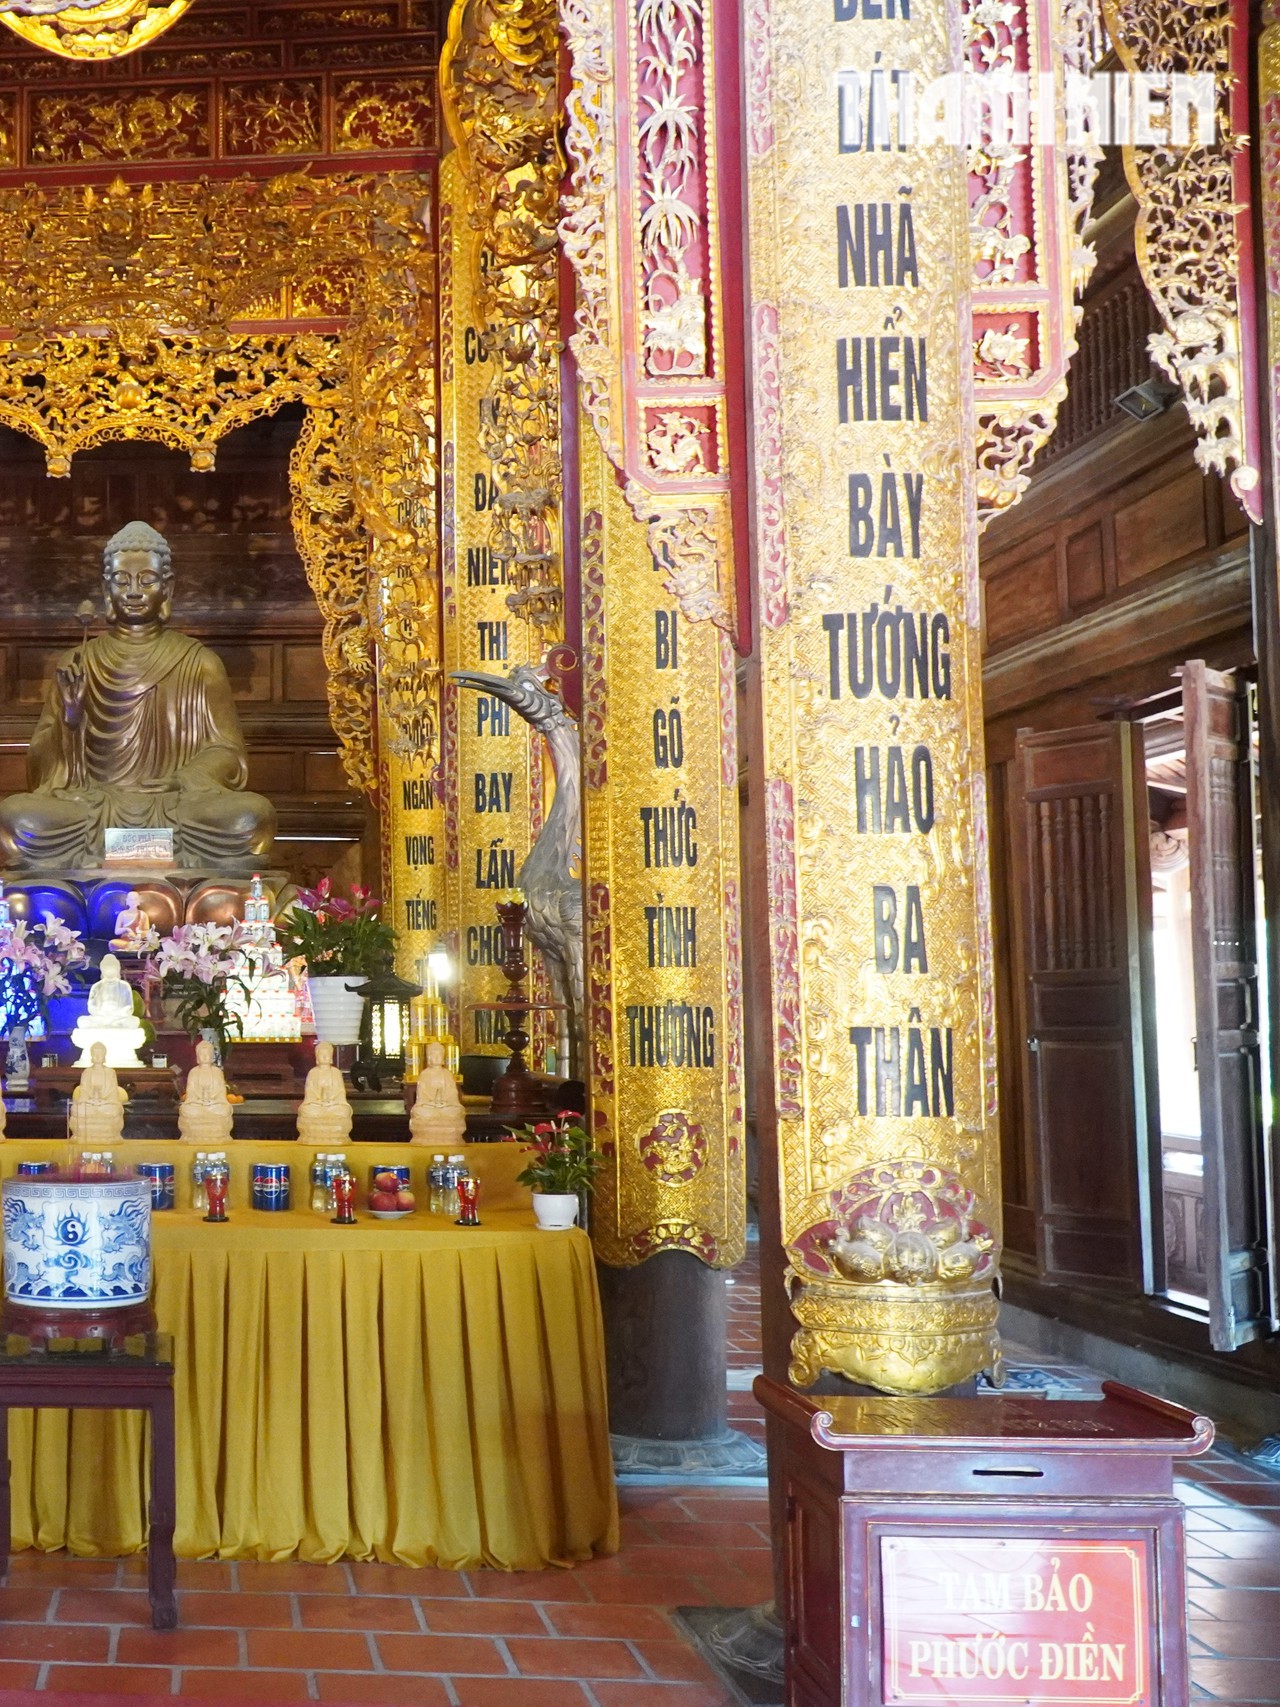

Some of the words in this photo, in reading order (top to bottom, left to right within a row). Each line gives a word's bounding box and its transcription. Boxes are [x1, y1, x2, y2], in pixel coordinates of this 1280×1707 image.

[836, 50, 912, 155] BÁT
[835, 185, 919, 290] NHÃ
[835, 306, 929, 425] HIỂN
[847, 452, 924, 560] BÀY
[477, 620, 509, 671] THỊ
[654, 609, 679, 671] BI
[821, 583, 952, 701] TƯỚNG
[476, 696, 510, 738] PHI
[652, 696, 685, 770] GÕ
[402, 777, 434, 811] NGÂN
[474, 772, 514, 814] BAY
[853, 714, 936, 835] HẢO
[405, 835, 435, 871] VỌNG
[474, 837, 516, 890] LẪN
[639, 787, 699, 869] THỨC
[405, 888, 437, 932] TIẾNG
[643, 893, 698, 968] TÌNH
[871, 884, 929, 976] BA
[625, 998, 715, 1070] THƯƠNG
[848, 1005, 956, 1118] THÂN
[939, 1571, 1013, 1612] TAM
[1022, 1556, 1094, 1613] BẢO
[908, 1630, 1030, 1681] PHƯỚC
[1038, 1621, 1127, 1682] ĐIỀN
